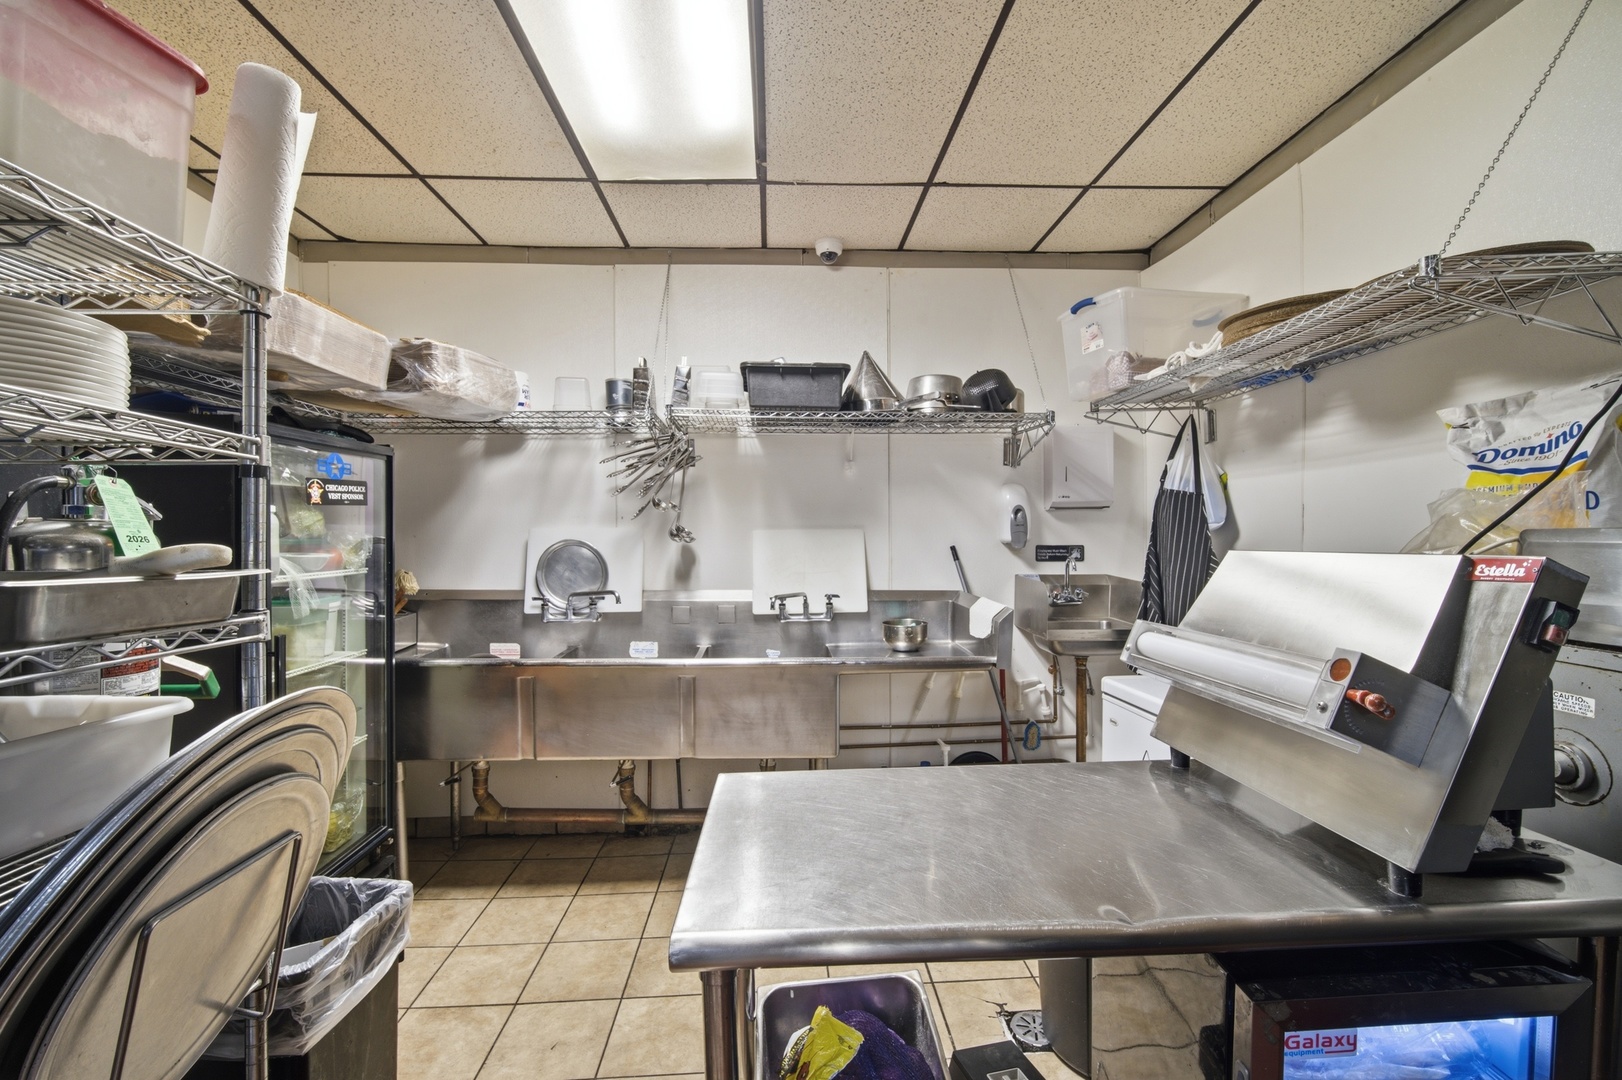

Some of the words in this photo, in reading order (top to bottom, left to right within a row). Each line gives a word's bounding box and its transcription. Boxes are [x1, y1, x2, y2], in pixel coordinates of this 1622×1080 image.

[1472, 420, 1583, 464] Domino
[1503, 457, 1532, 466] Since
[325, 484, 348, 492] CHICAGO
[349, 485, 366, 493] POLICE
[327, 492, 341, 500] VEST
[126, 535, 150, 544] 2026
[1474, 563, 1526, 577] Estella
[1284, 1033, 1357, 1052] Galaxy
[1284, 1048, 1324, 1058] equipment
